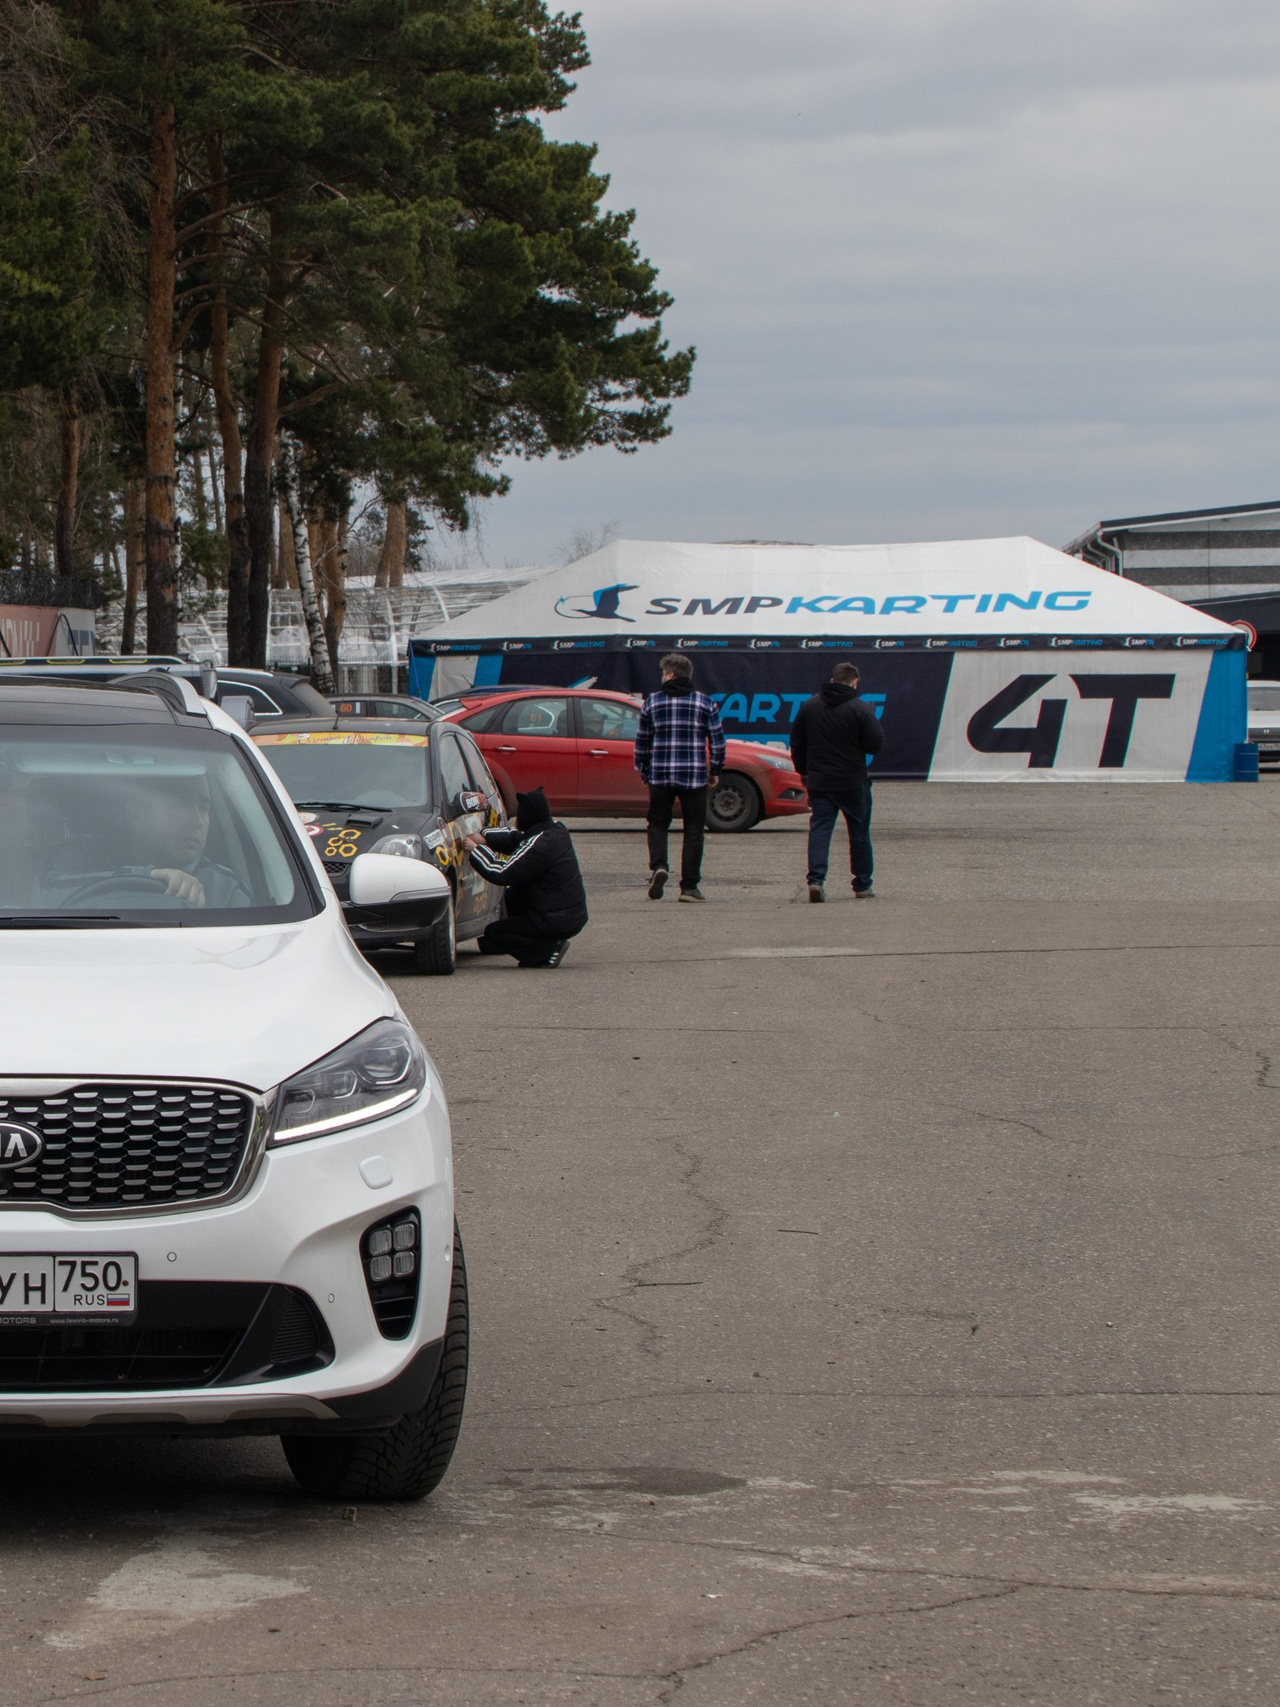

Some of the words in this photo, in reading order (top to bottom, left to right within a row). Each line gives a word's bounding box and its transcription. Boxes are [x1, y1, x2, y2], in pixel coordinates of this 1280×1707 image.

[966, 673, 1176, 768] 4T
[58, 1260, 123, 1292] 750
[73, 1294, 106, 1306] RUS
